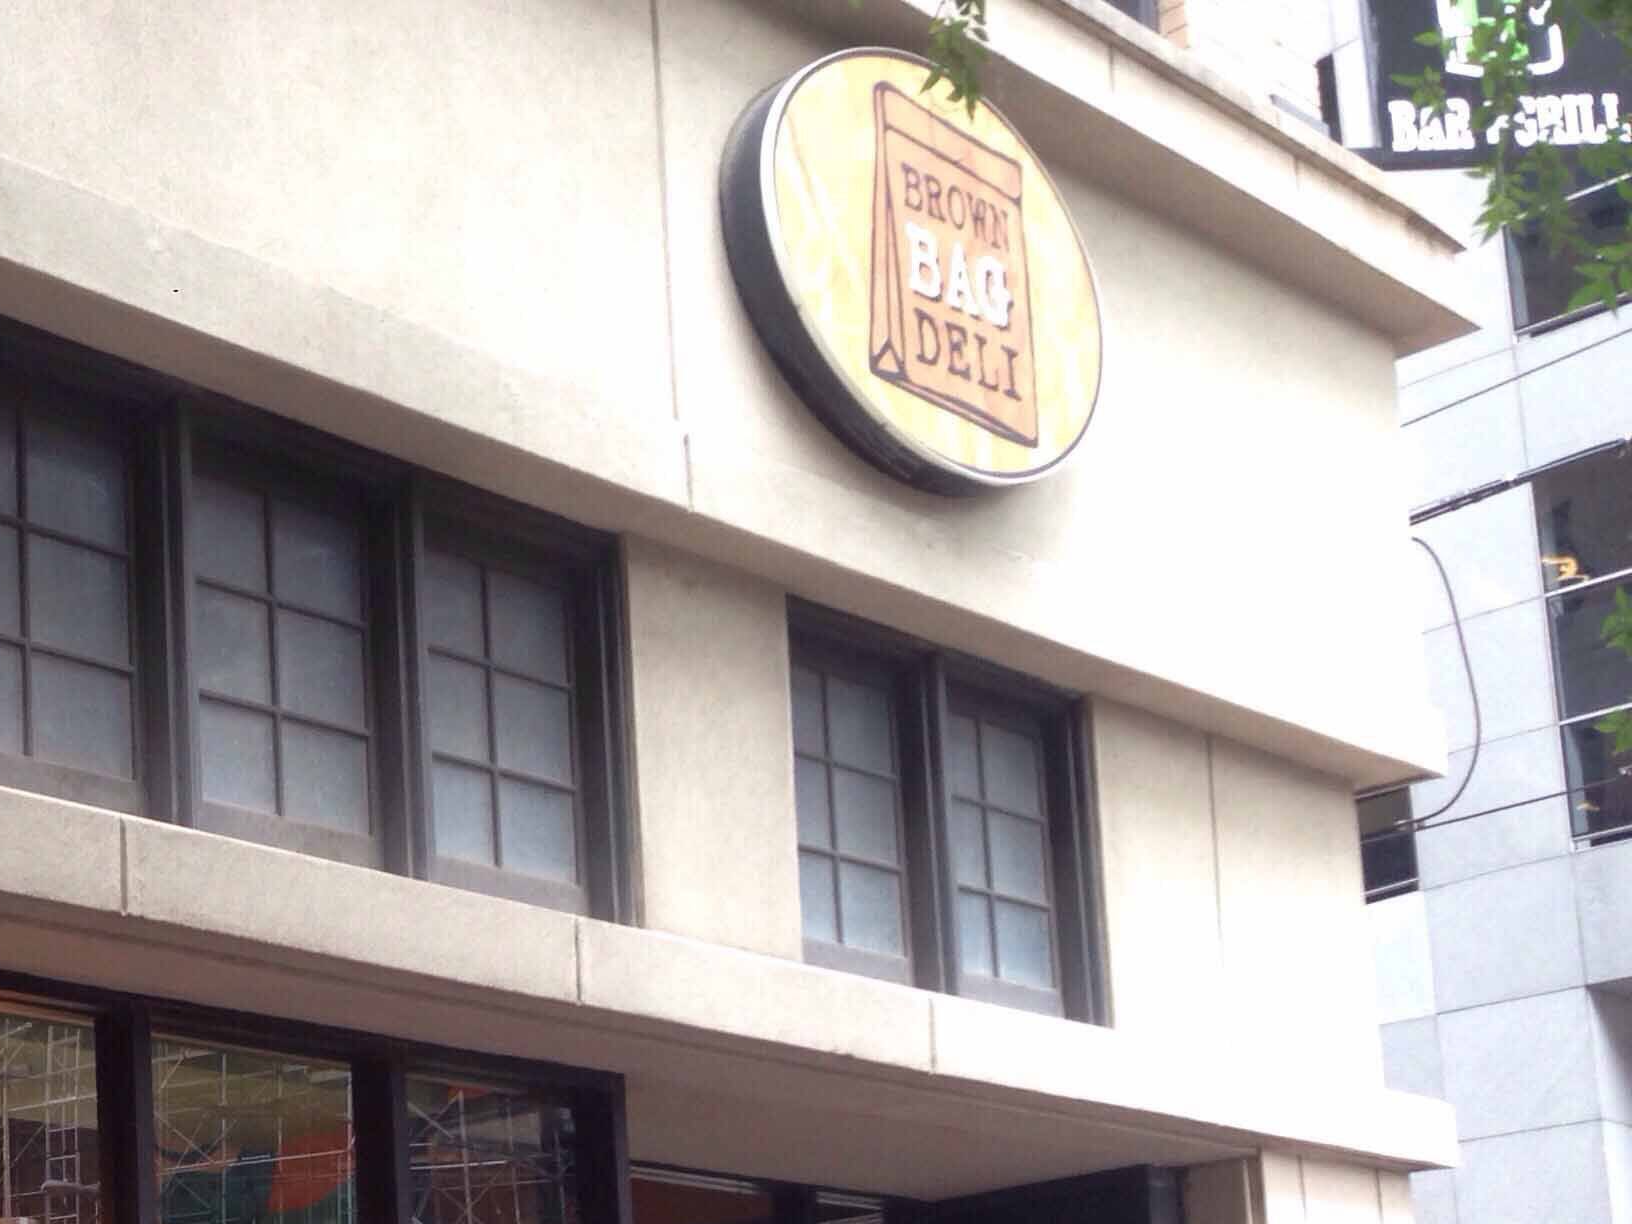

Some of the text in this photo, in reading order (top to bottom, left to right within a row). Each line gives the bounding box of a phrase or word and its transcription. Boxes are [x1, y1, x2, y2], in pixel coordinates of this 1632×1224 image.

[901, 161, 1010, 251] BROWN
[905, 219, 1014, 331] BAG
[914, 307, 1022, 402] DELI
